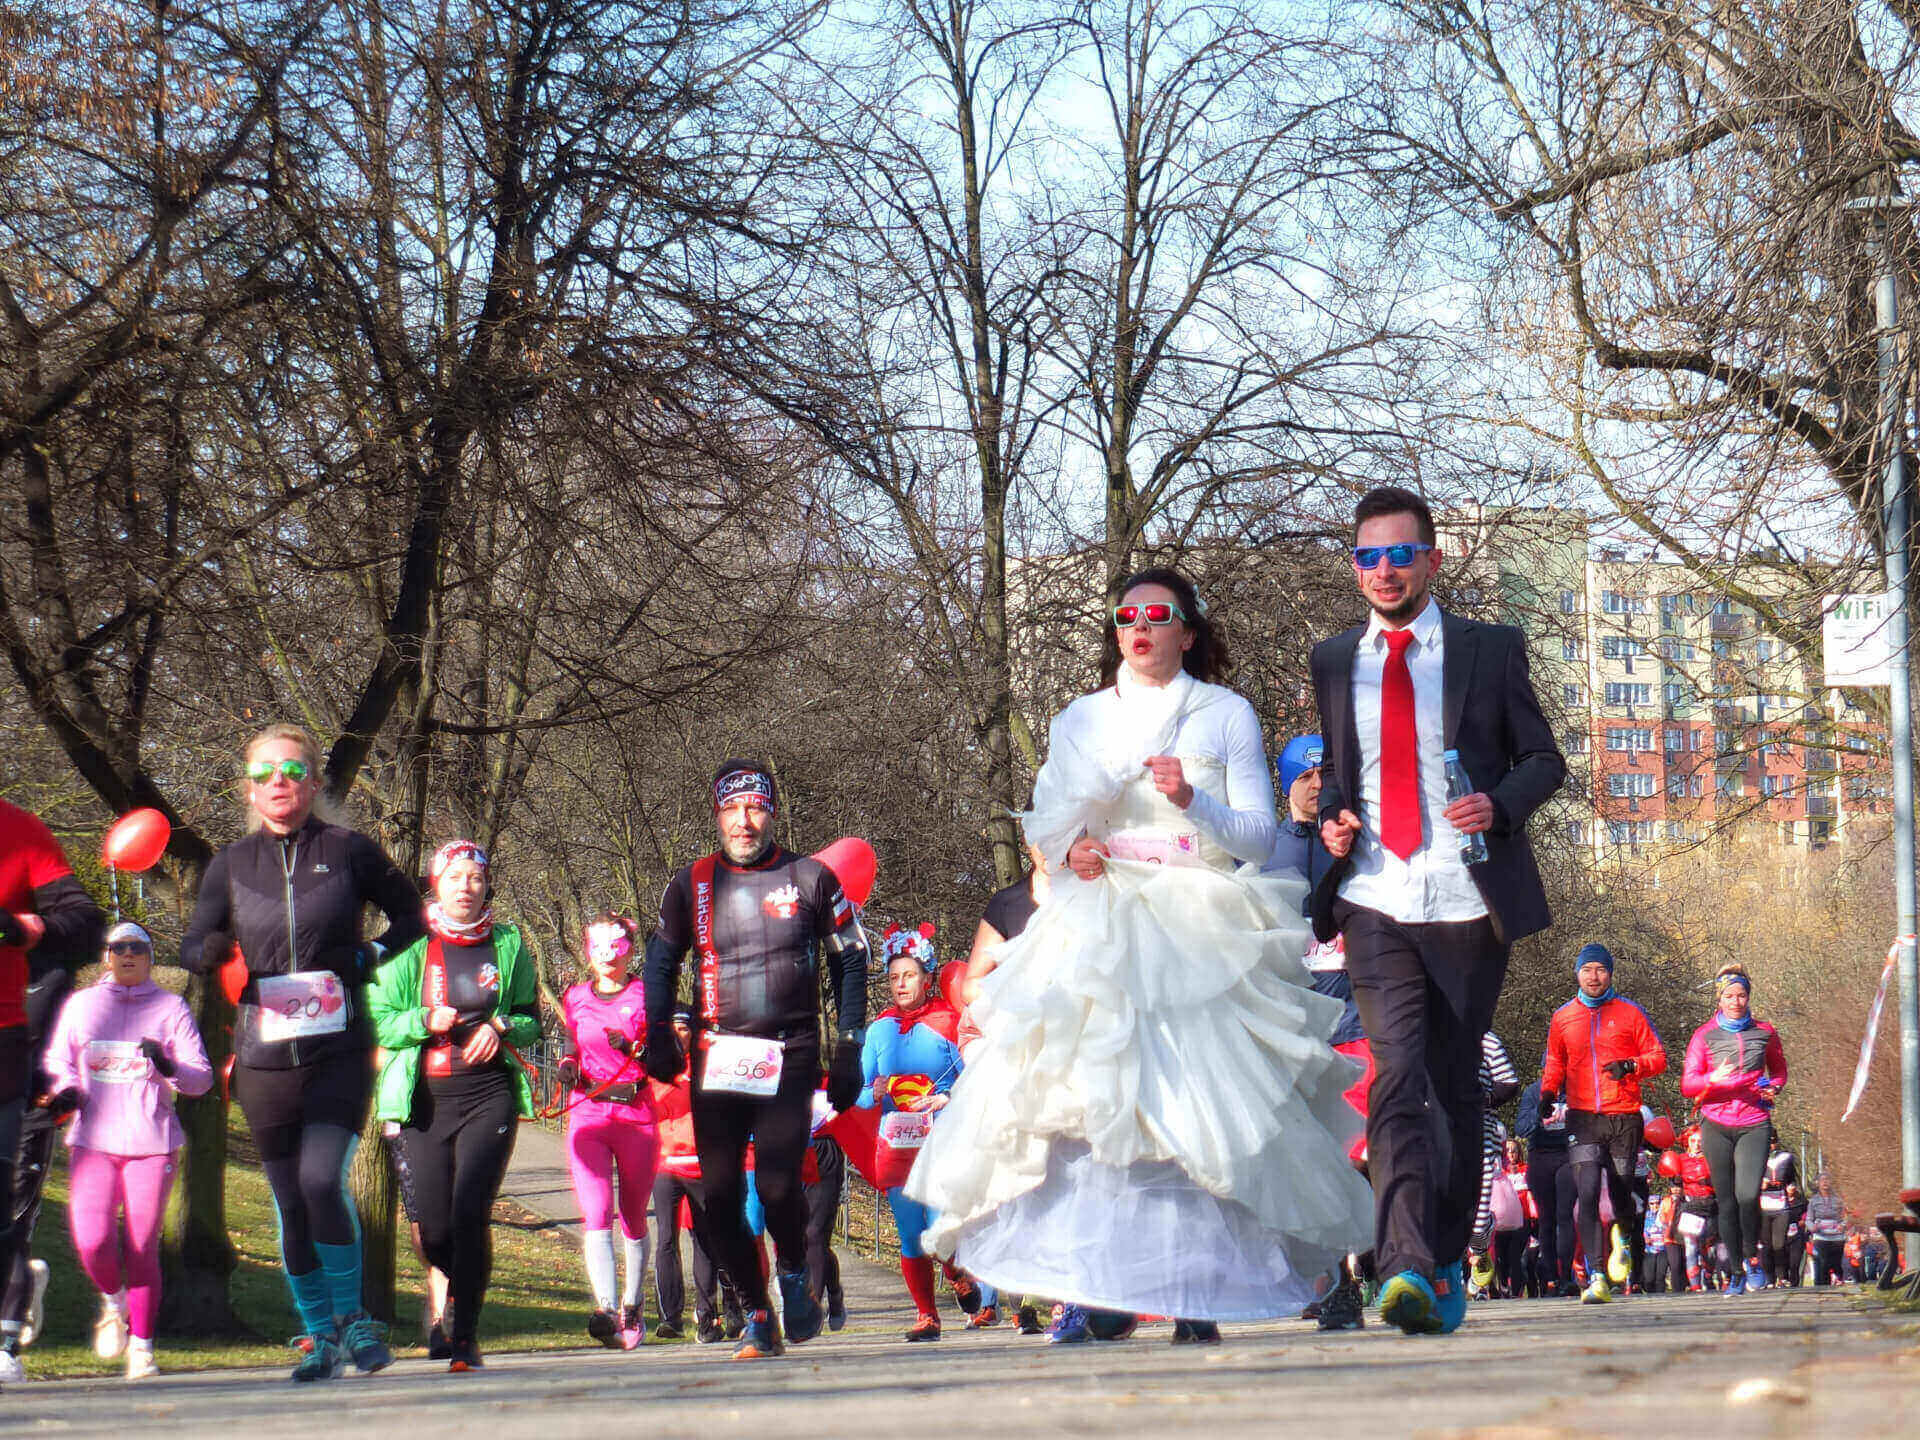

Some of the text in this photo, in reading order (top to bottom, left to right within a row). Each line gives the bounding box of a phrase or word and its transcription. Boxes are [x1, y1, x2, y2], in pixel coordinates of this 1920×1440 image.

[1834, 601, 1881, 620] WiFi
[697, 881, 709, 945] DUCHEM
[284, 996, 322, 1019] 20
